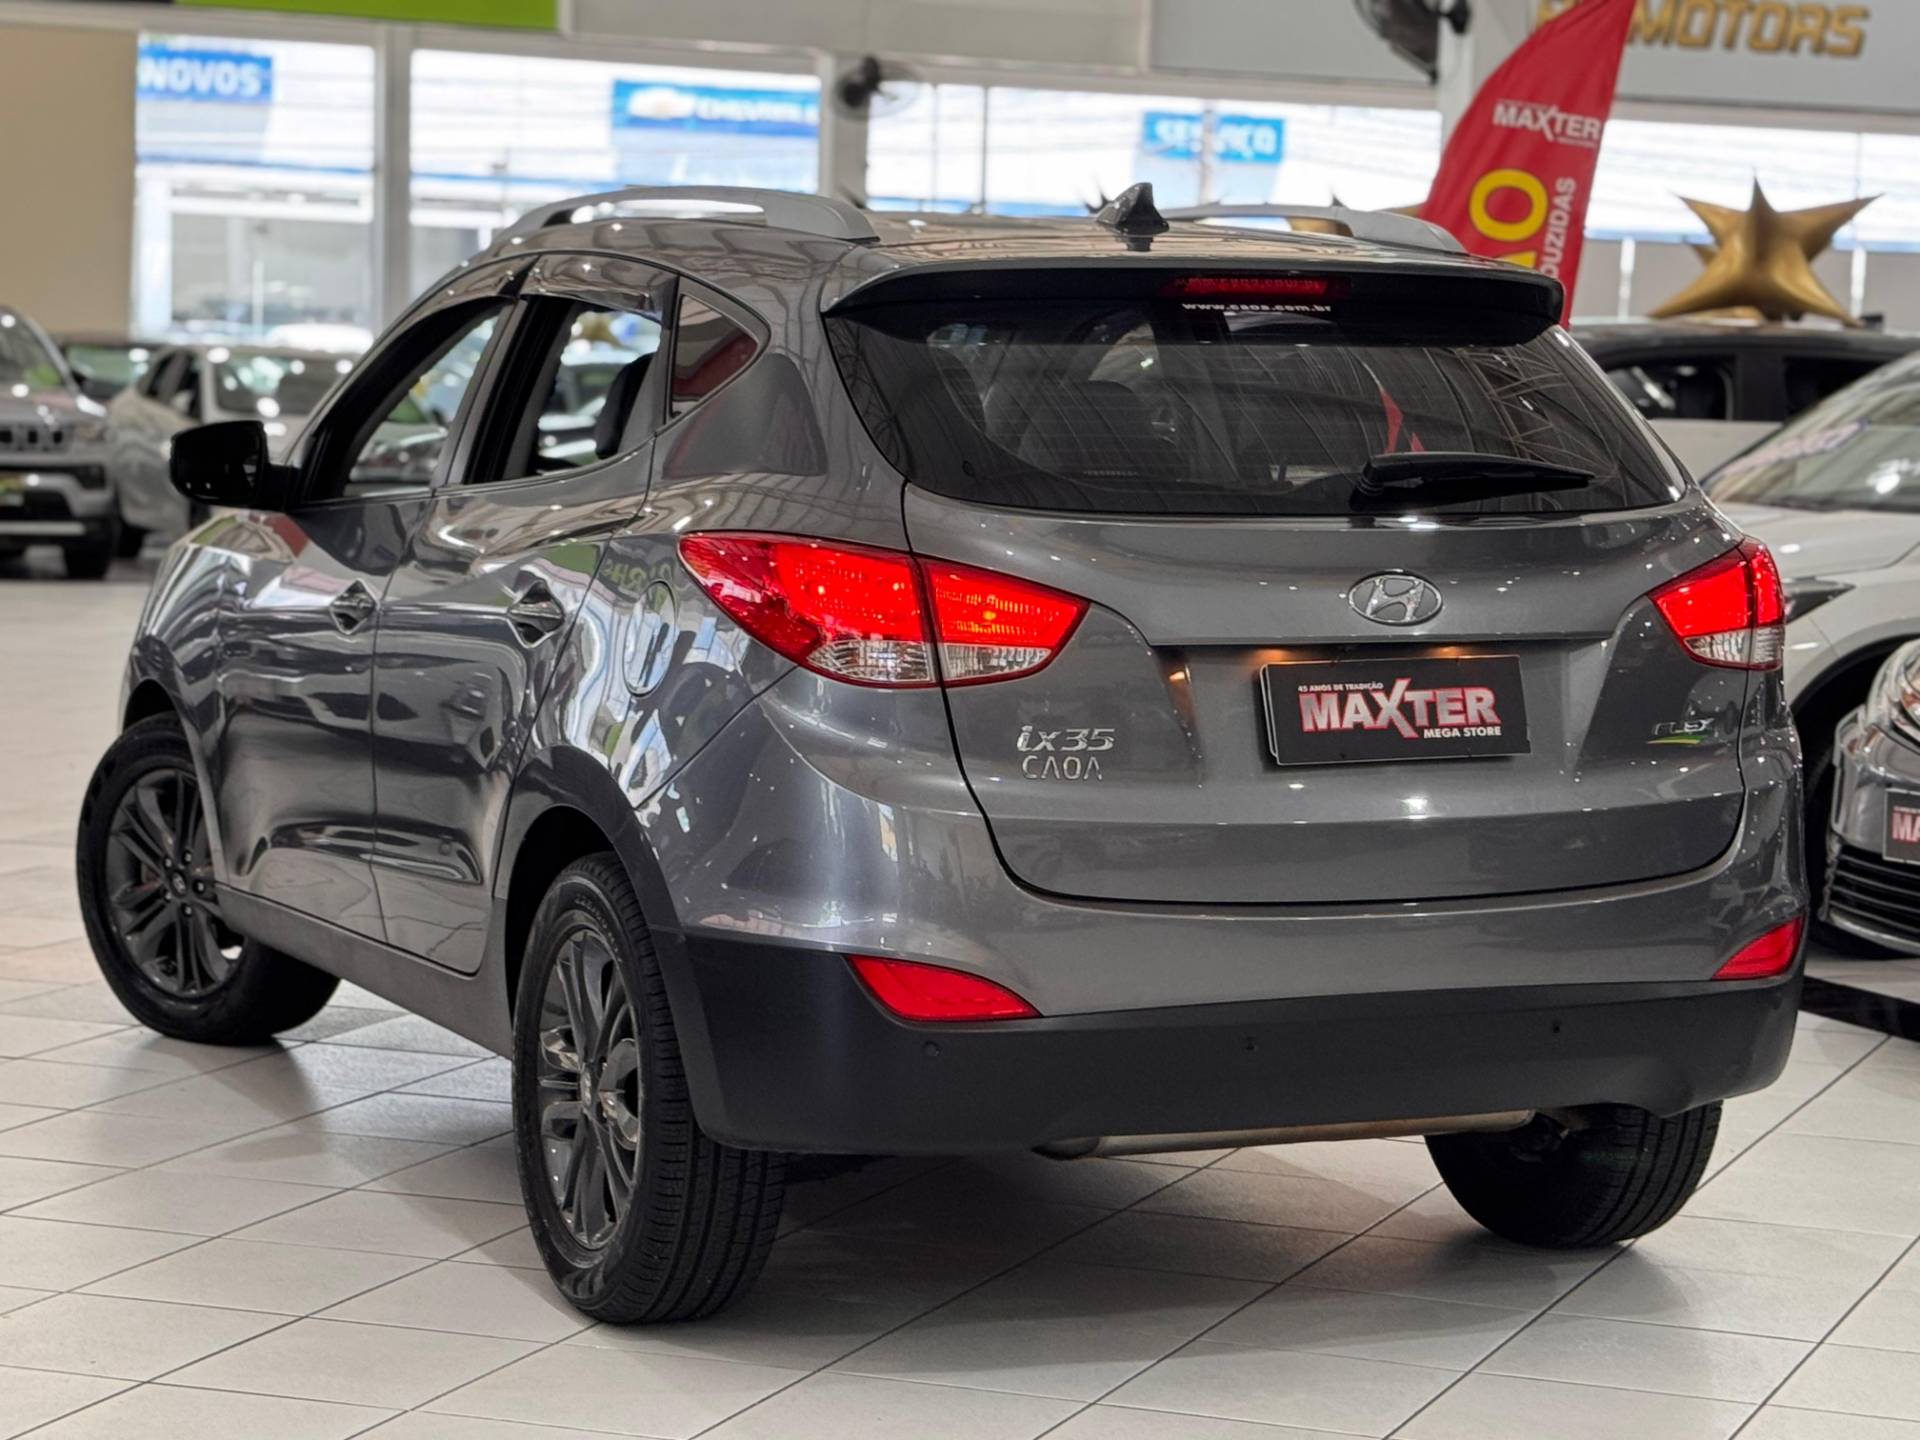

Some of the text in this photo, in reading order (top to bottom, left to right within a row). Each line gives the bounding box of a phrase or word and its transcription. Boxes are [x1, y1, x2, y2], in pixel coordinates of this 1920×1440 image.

[1628, 0, 1869, 57] MOTORS
[138, 57, 261, 97] NOVOS
[1493, 103, 1600, 142] MAXTER
[1182, 303, 1332, 312] www.caoa.com.br
[1333, 683, 1343, 691] DE
[1299, 678, 1502, 738] MAXTER
[1423, 727, 1502, 739] MEGA STORE
